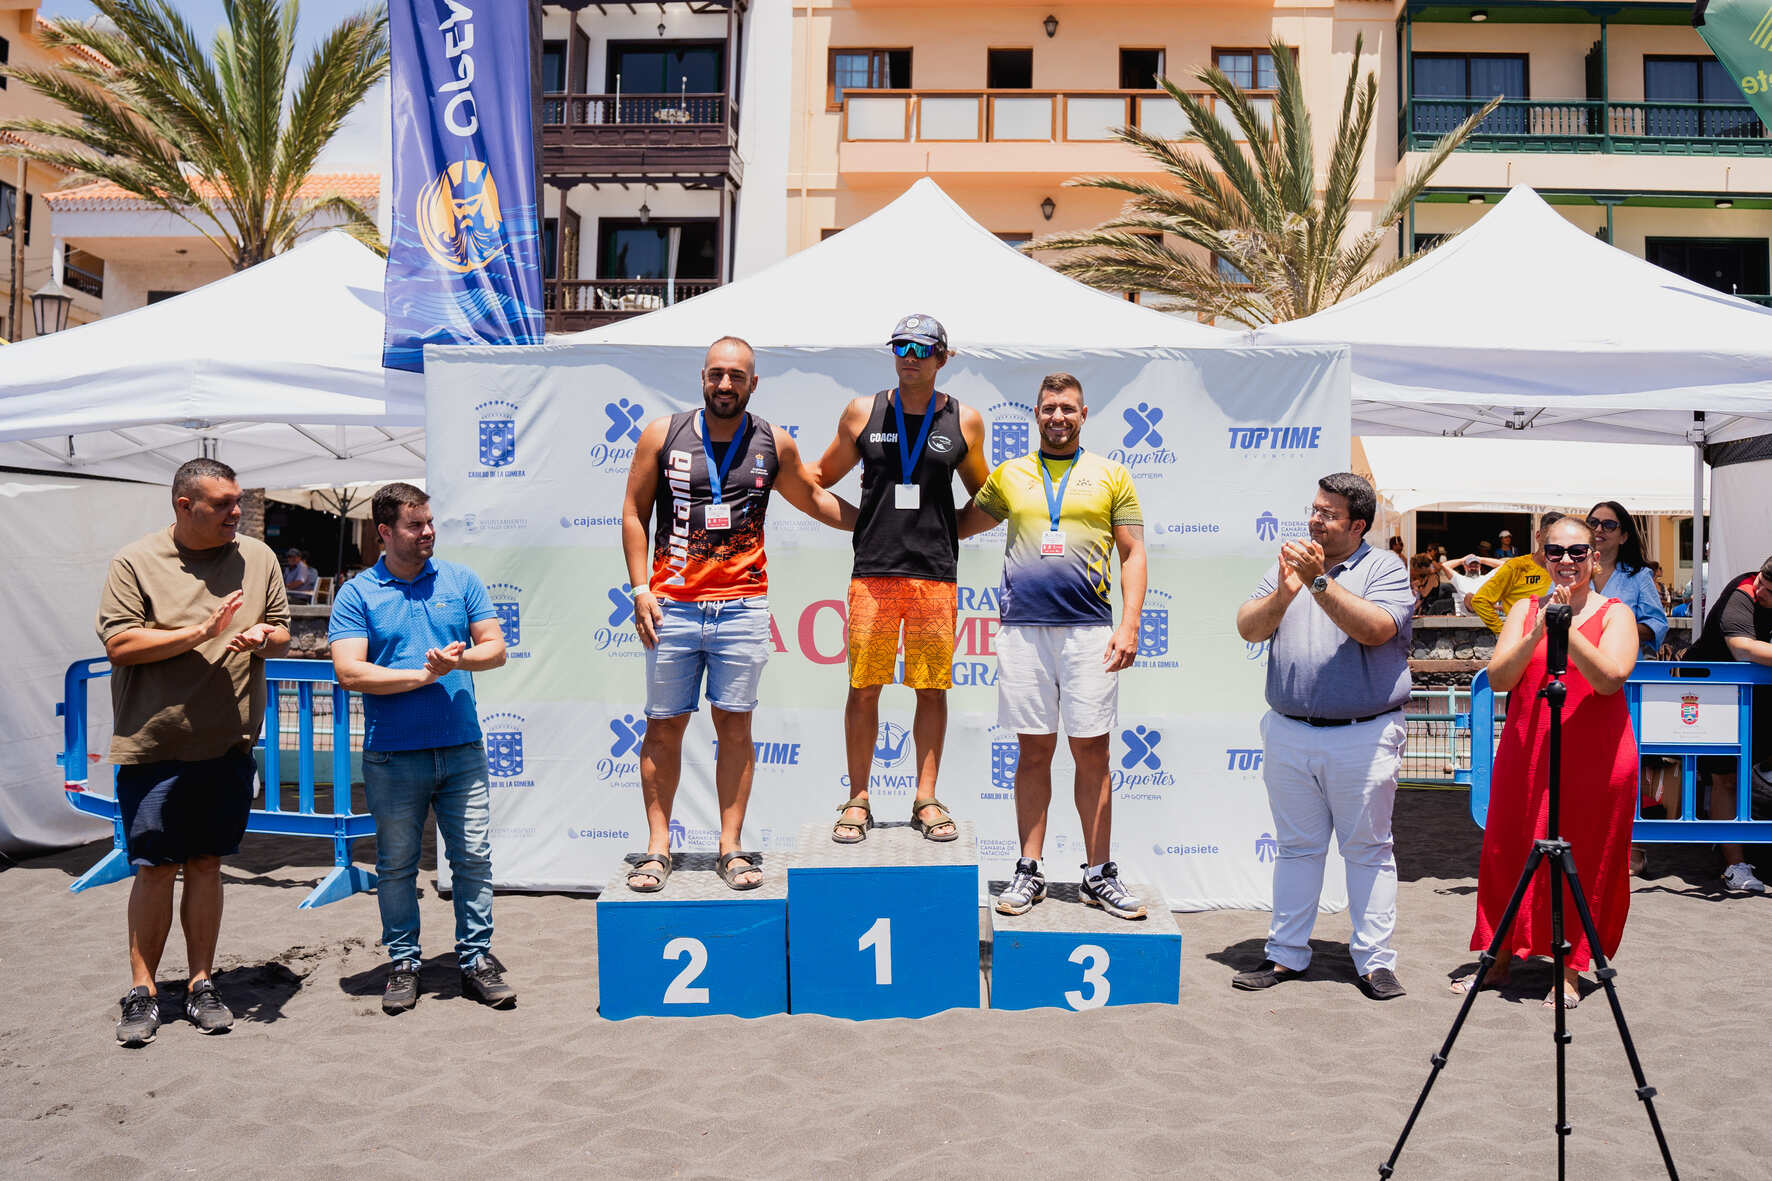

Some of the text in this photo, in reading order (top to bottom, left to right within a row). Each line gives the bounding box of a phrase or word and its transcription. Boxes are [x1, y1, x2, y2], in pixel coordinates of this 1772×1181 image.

[869, 432, 898, 443] COACH
[573, 516, 623, 528] cajasiete
[1167, 521, 1221, 535] cajasiete
[1524, 575, 1541, 585] TOP
[1110, 769, 1176, 793] Deportes
[580, 828, 630, 840] cajasiete
[1167, 844, 1219, 856] cajasiete
[857, 917, 893, 985] 1
[662, 937, 710, 1004] 2
[1064, 944, 1112, 1012] 3
